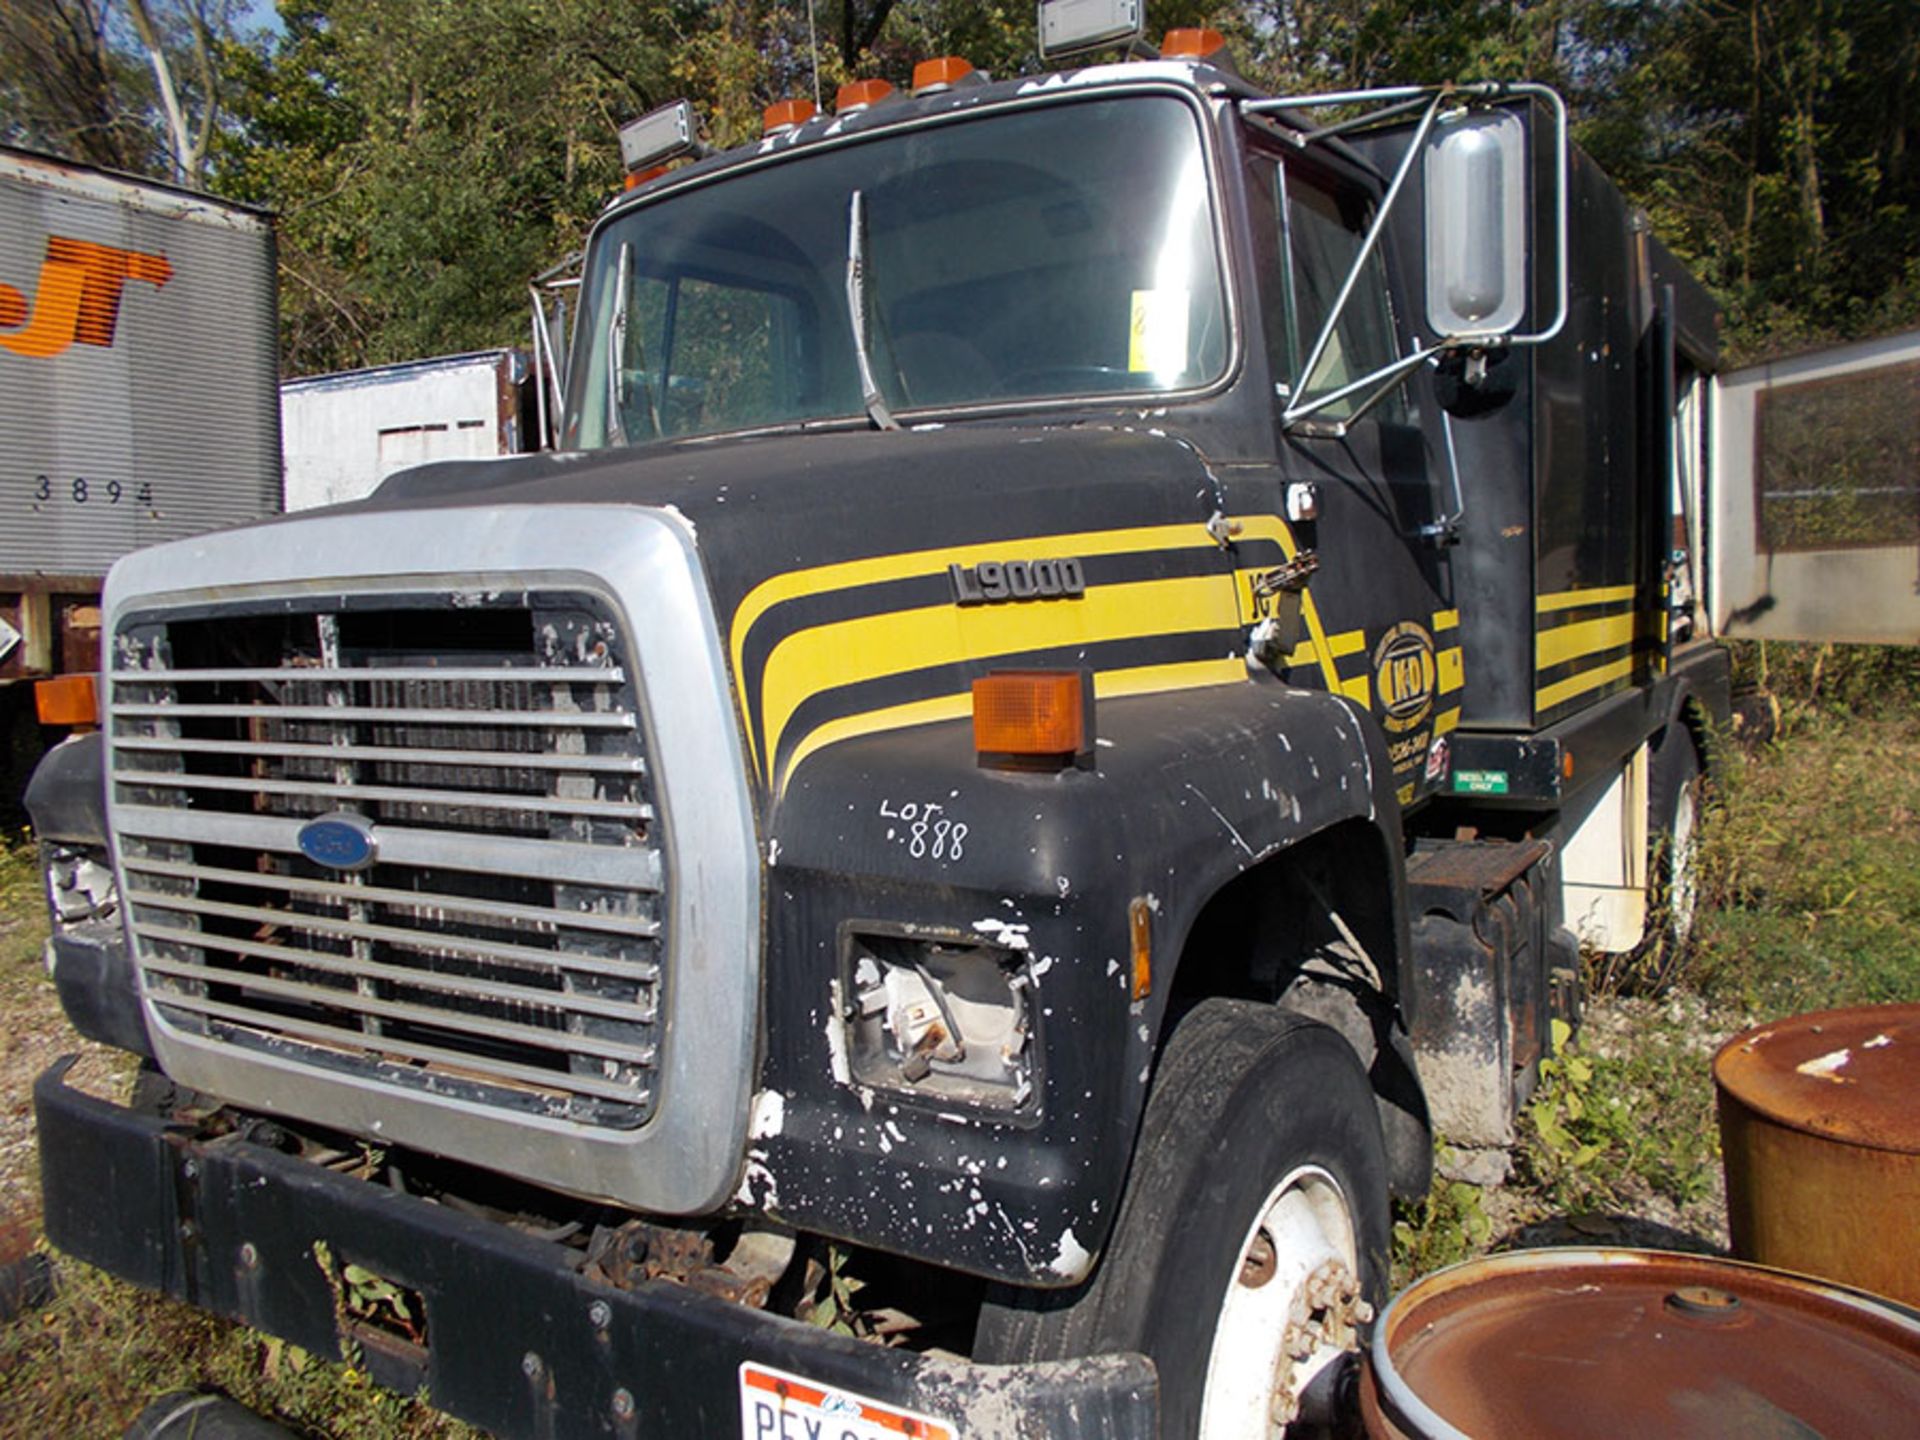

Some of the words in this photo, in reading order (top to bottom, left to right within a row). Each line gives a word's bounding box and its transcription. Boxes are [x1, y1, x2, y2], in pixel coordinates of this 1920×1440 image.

[35, 475, 153, 506] 3894
[948, 557, 1086, 607] L9000
[880, 799, 943, 822] LOT
